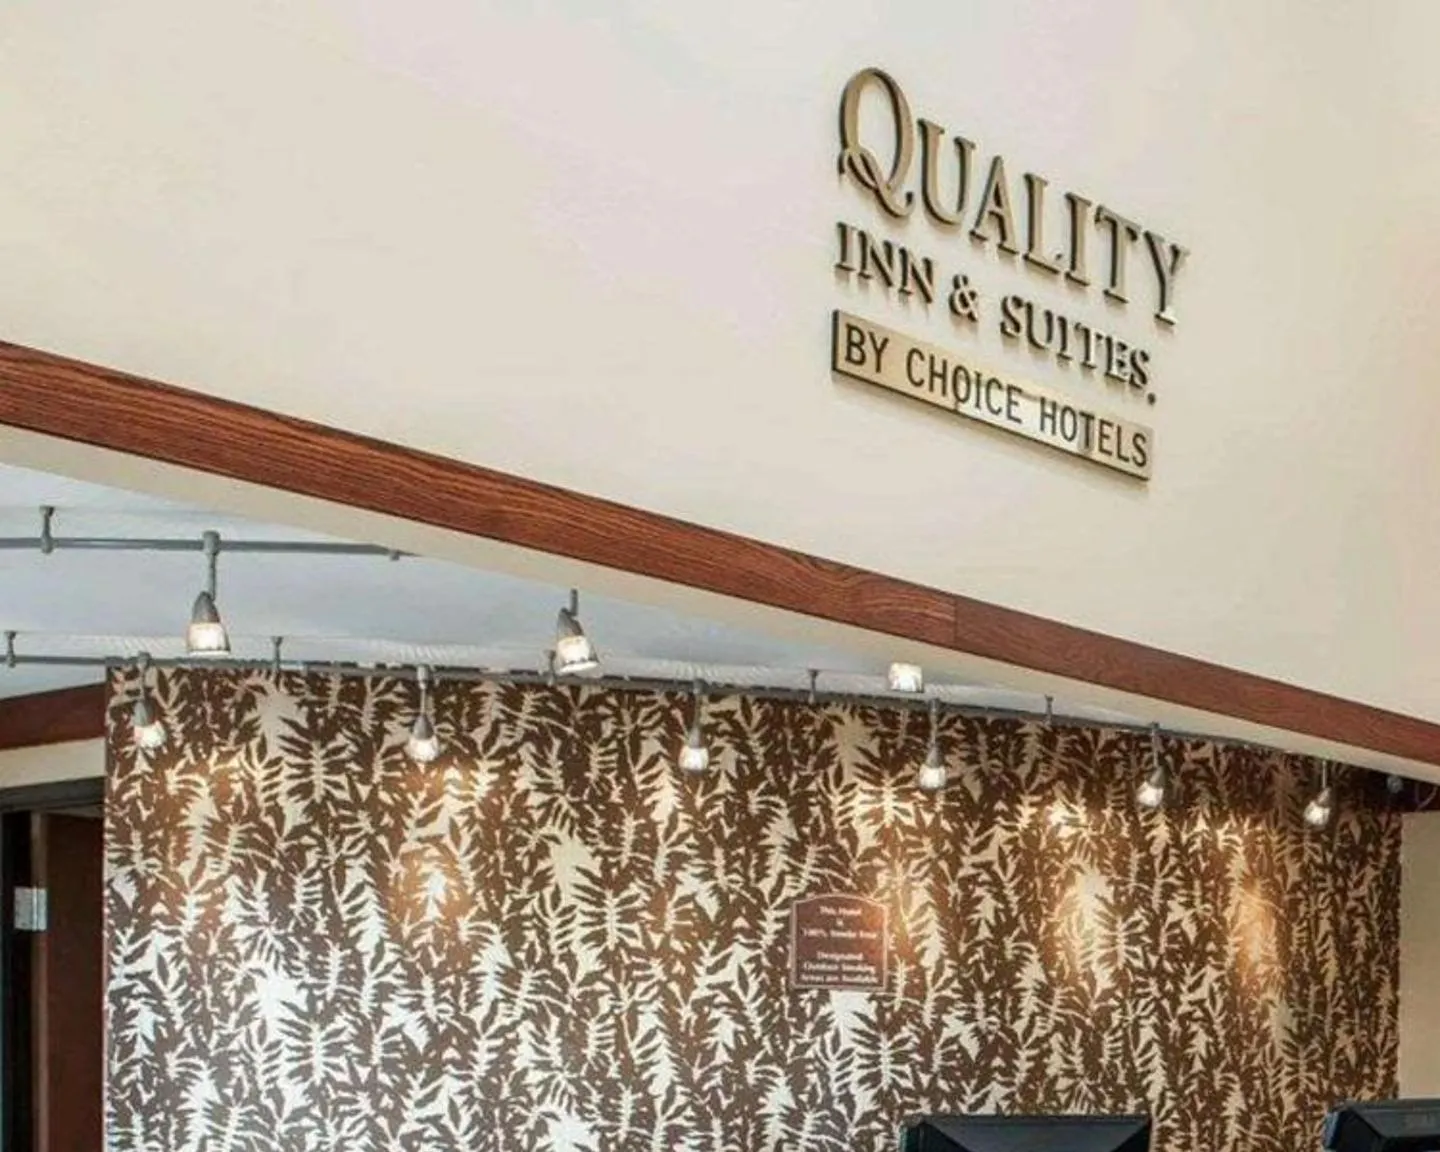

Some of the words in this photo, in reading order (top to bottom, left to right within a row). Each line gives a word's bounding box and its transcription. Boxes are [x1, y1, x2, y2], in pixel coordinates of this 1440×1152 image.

[838, 67, 1189, 326] QUALITY
[835, 222, 935, 304] INN
[949, 273, 979, 323] &
[845, 322, 889, 373] BY
[905, 347, 1023, 424] CHOICE
[1039, 396, 1149, 469] HOTELS
